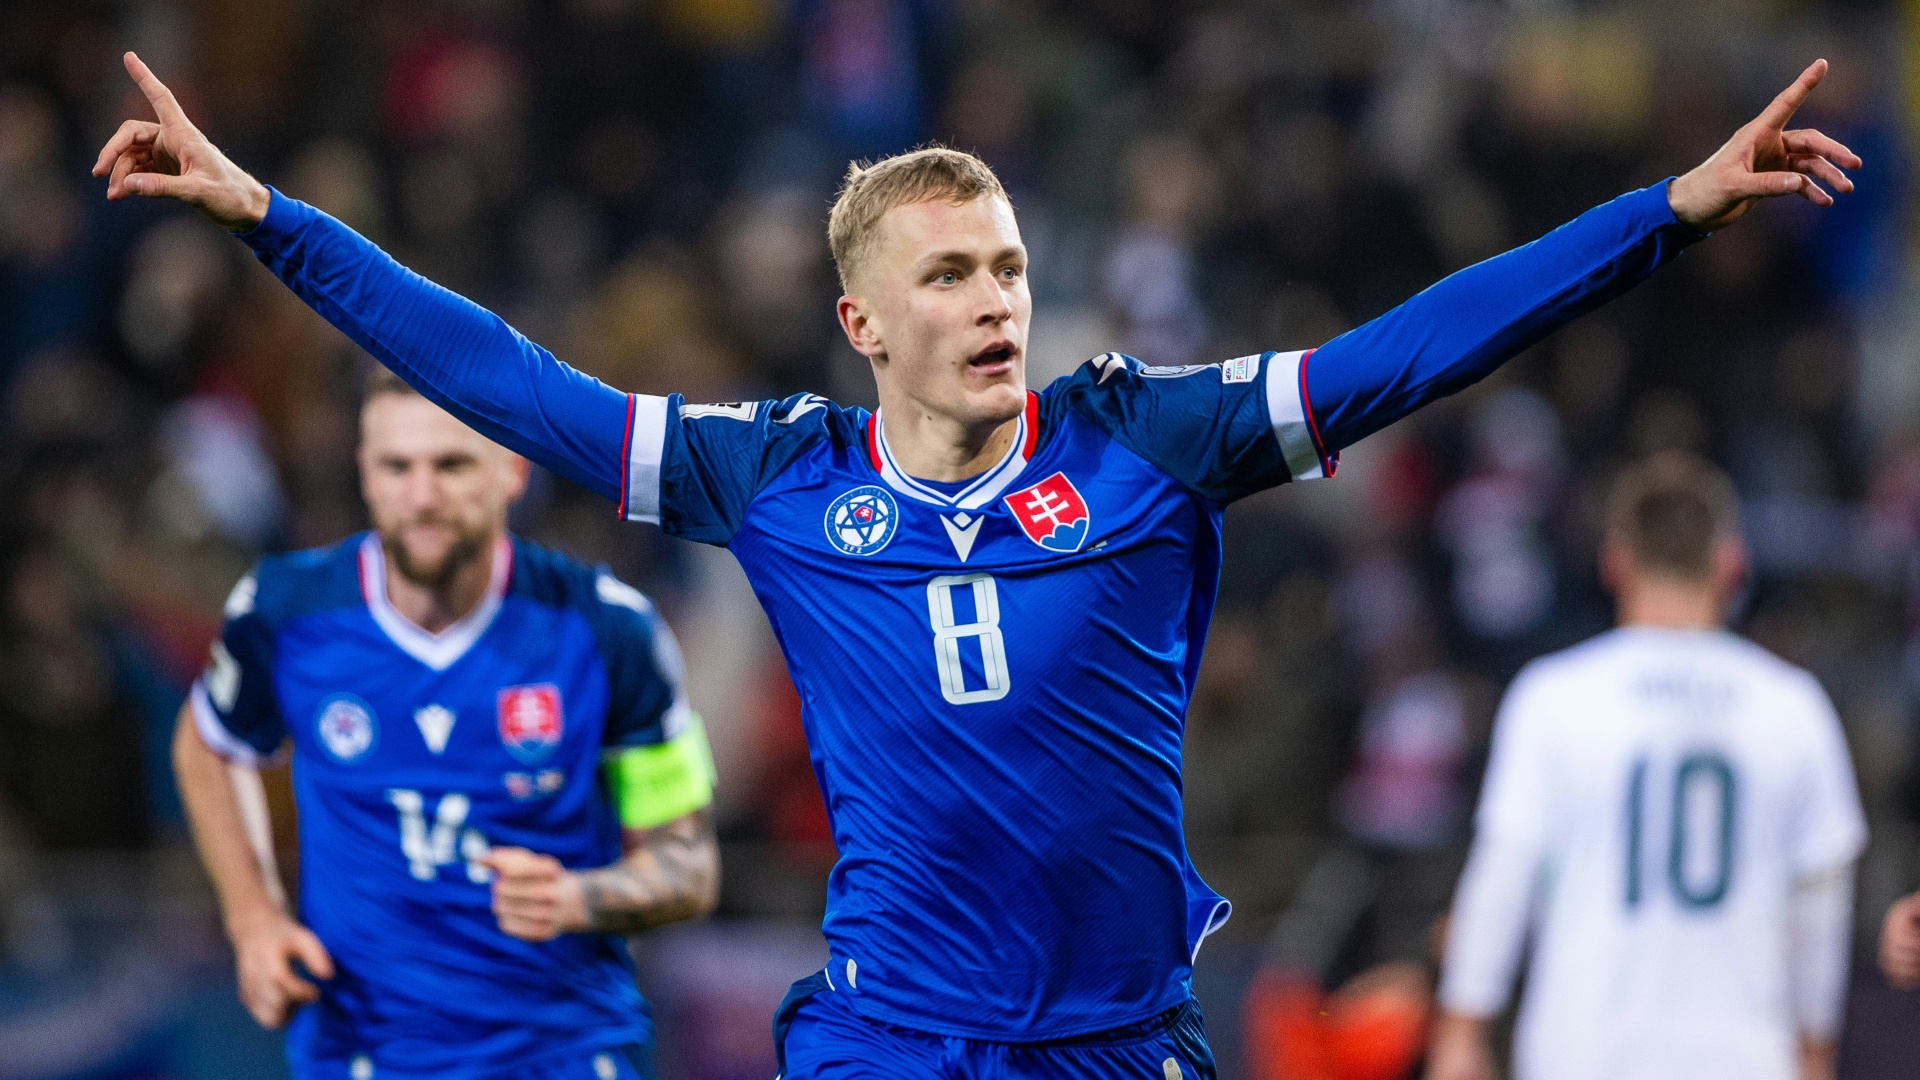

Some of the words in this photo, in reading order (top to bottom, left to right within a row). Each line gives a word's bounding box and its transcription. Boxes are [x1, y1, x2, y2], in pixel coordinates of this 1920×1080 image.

[842, 543, 863, 554] SFZ
[927, 572, 1011, 705] 8
[386, 788, 492, 884] 14
[1623, 752, 1738, 908] 10
